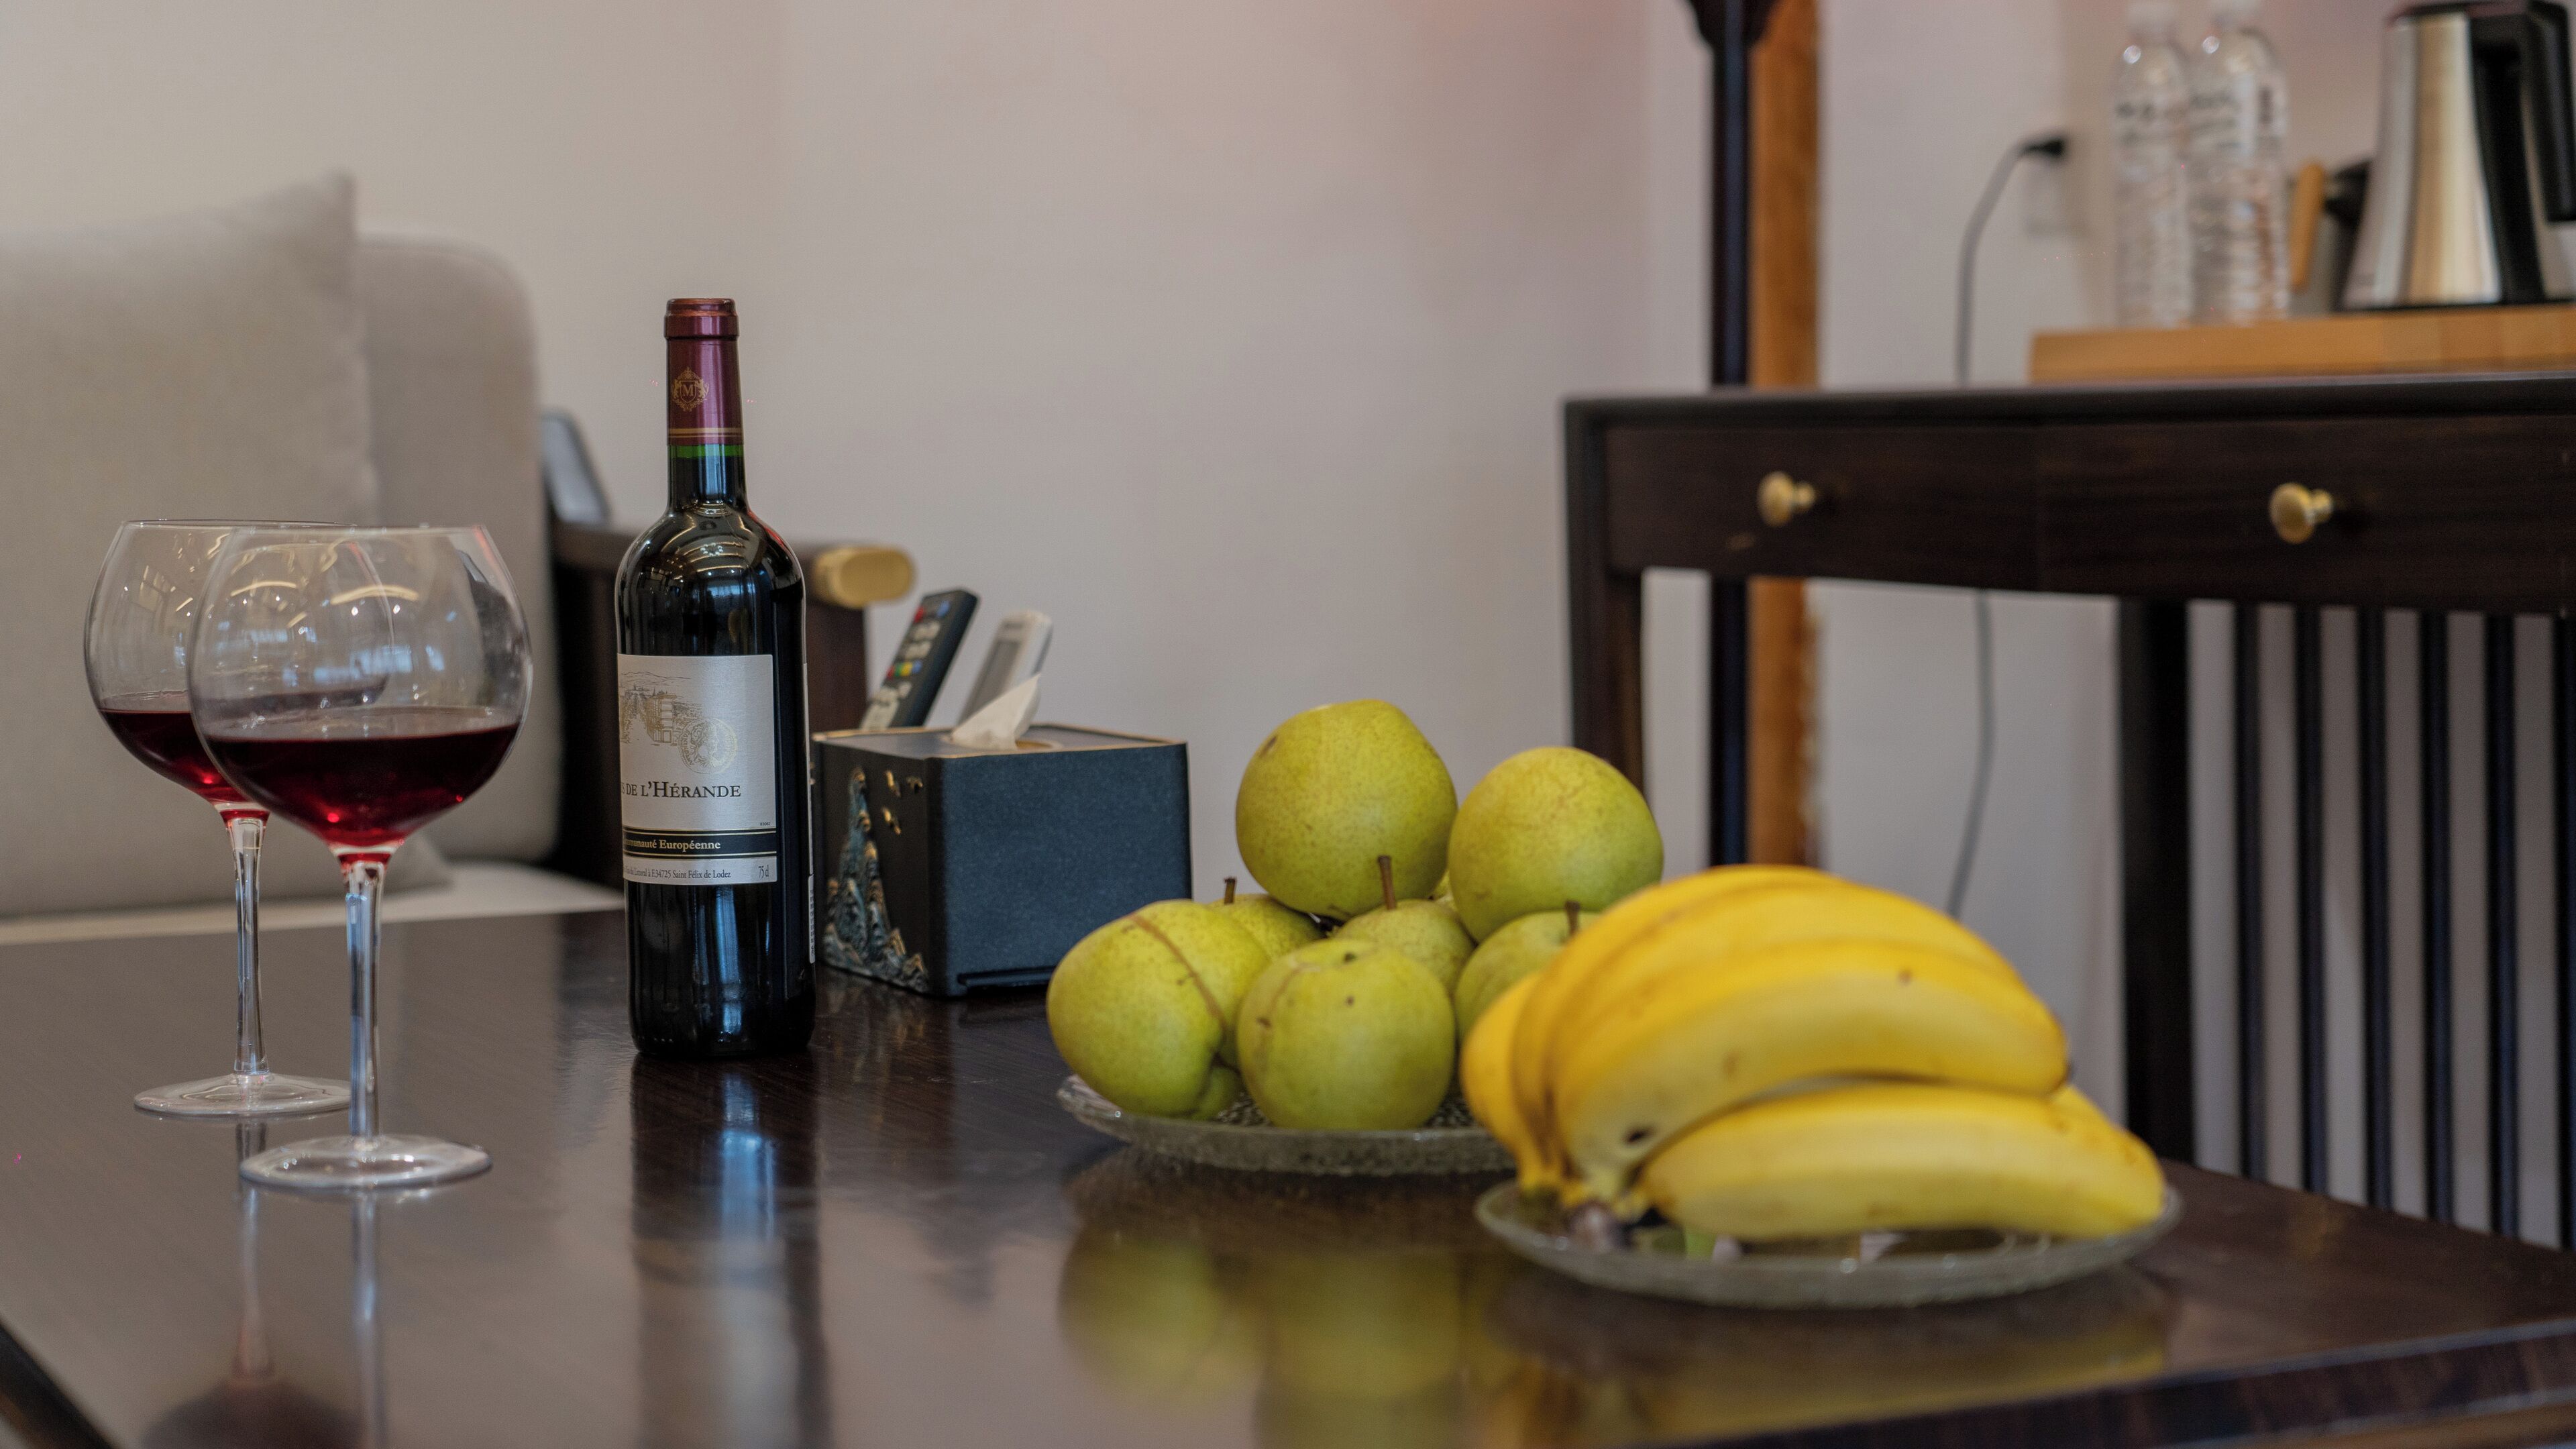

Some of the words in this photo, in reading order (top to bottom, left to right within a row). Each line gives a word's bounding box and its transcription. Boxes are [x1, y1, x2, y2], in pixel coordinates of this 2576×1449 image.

[682, 384, 694, 396] M
[626, 783, 637, 796] DE
[659, 839, 720, 852] Européenne
[673, 870, 686, 878] Saint
[688, 870, 702, 878] Félix
[704, 870, 711, 878] de
[713, 869, 731, 878] Lodez
